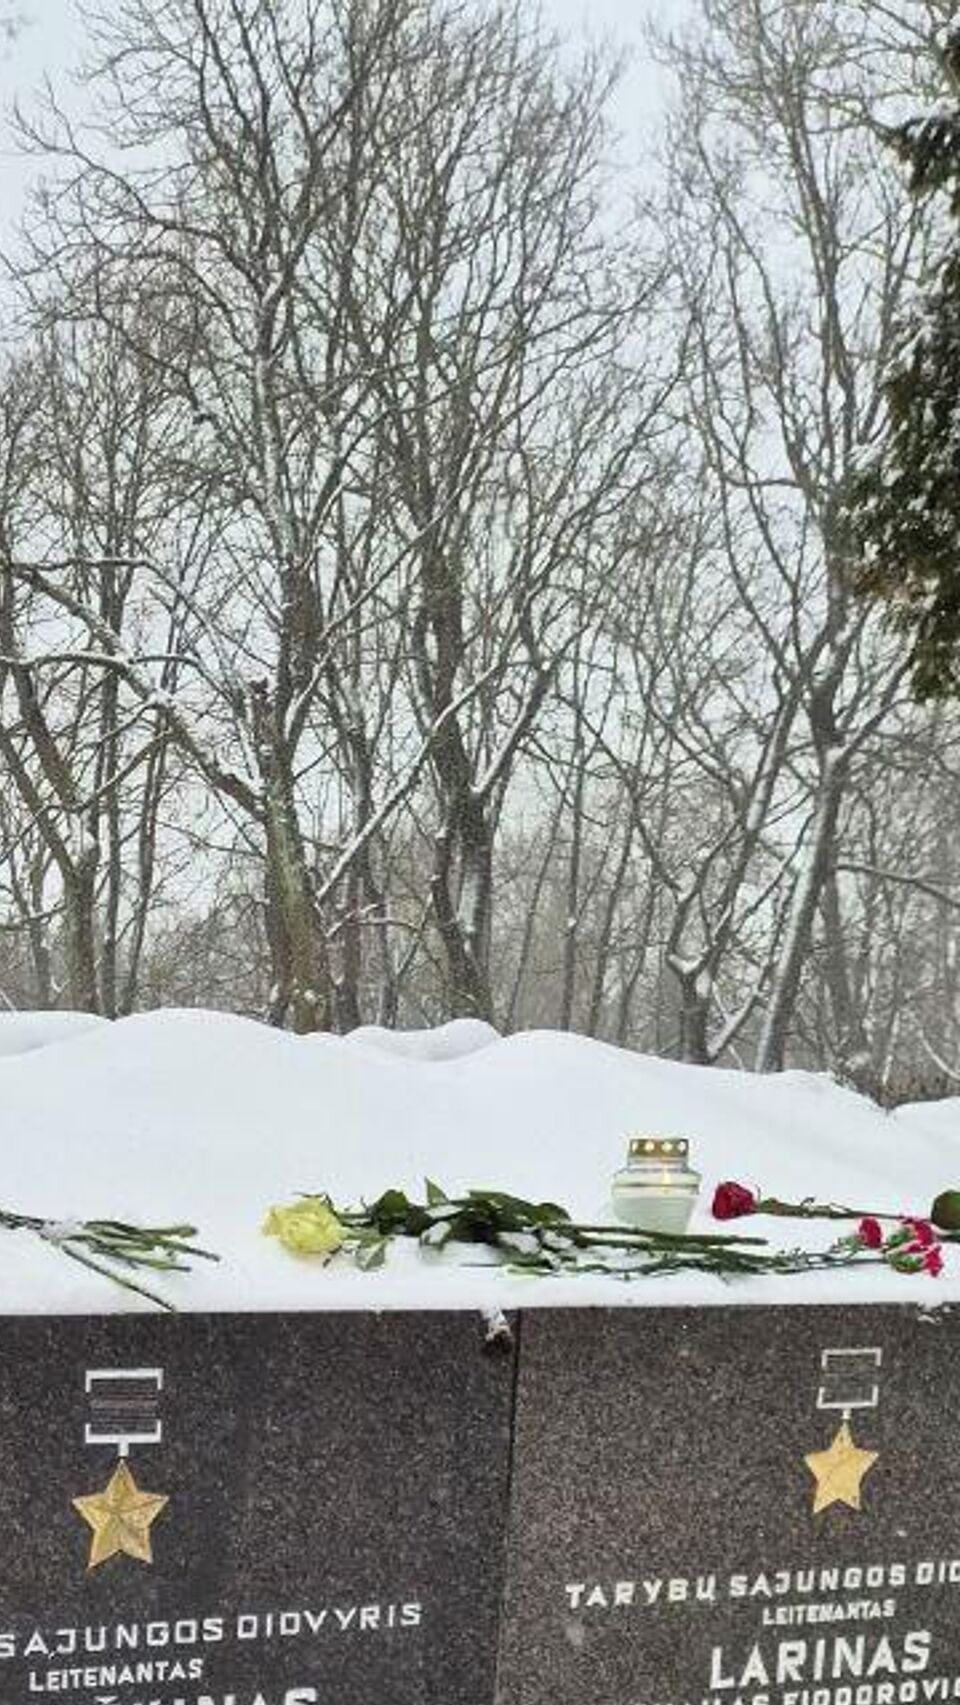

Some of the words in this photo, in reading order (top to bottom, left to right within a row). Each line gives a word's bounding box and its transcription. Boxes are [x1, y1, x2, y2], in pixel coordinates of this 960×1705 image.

[238, 1602, 424, 1641] DIDVYRIS
[762, 1598, 897, 1627] LEITENANTAS
[28, 1657, 204, 1692] LEITENANTAS
[709, 1629, 932, 1690] LARINAS
